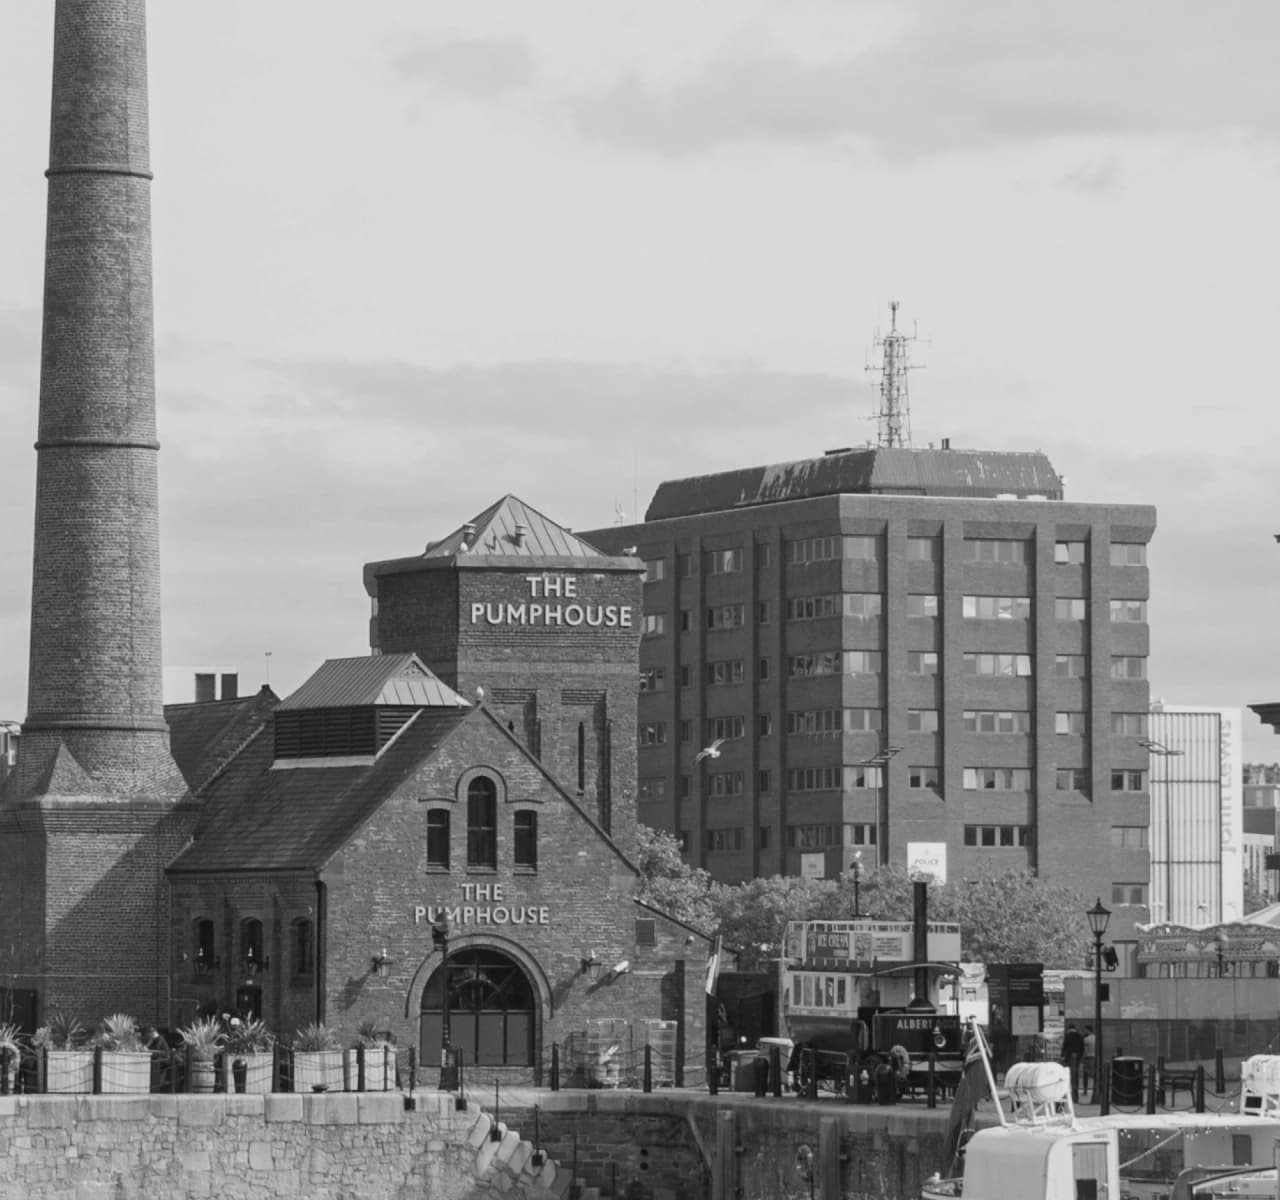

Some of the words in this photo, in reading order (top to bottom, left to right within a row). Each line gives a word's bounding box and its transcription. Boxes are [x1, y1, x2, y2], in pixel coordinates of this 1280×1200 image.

[526, 576, 577, 598] THE
[471, 603, 633, 627] PUMPHOUSE
[461, 883, 504, 901] THE
[415, 906, 550, 924] PUMPHOUSE
[896, 1018, 933, 1030] ALBERT
